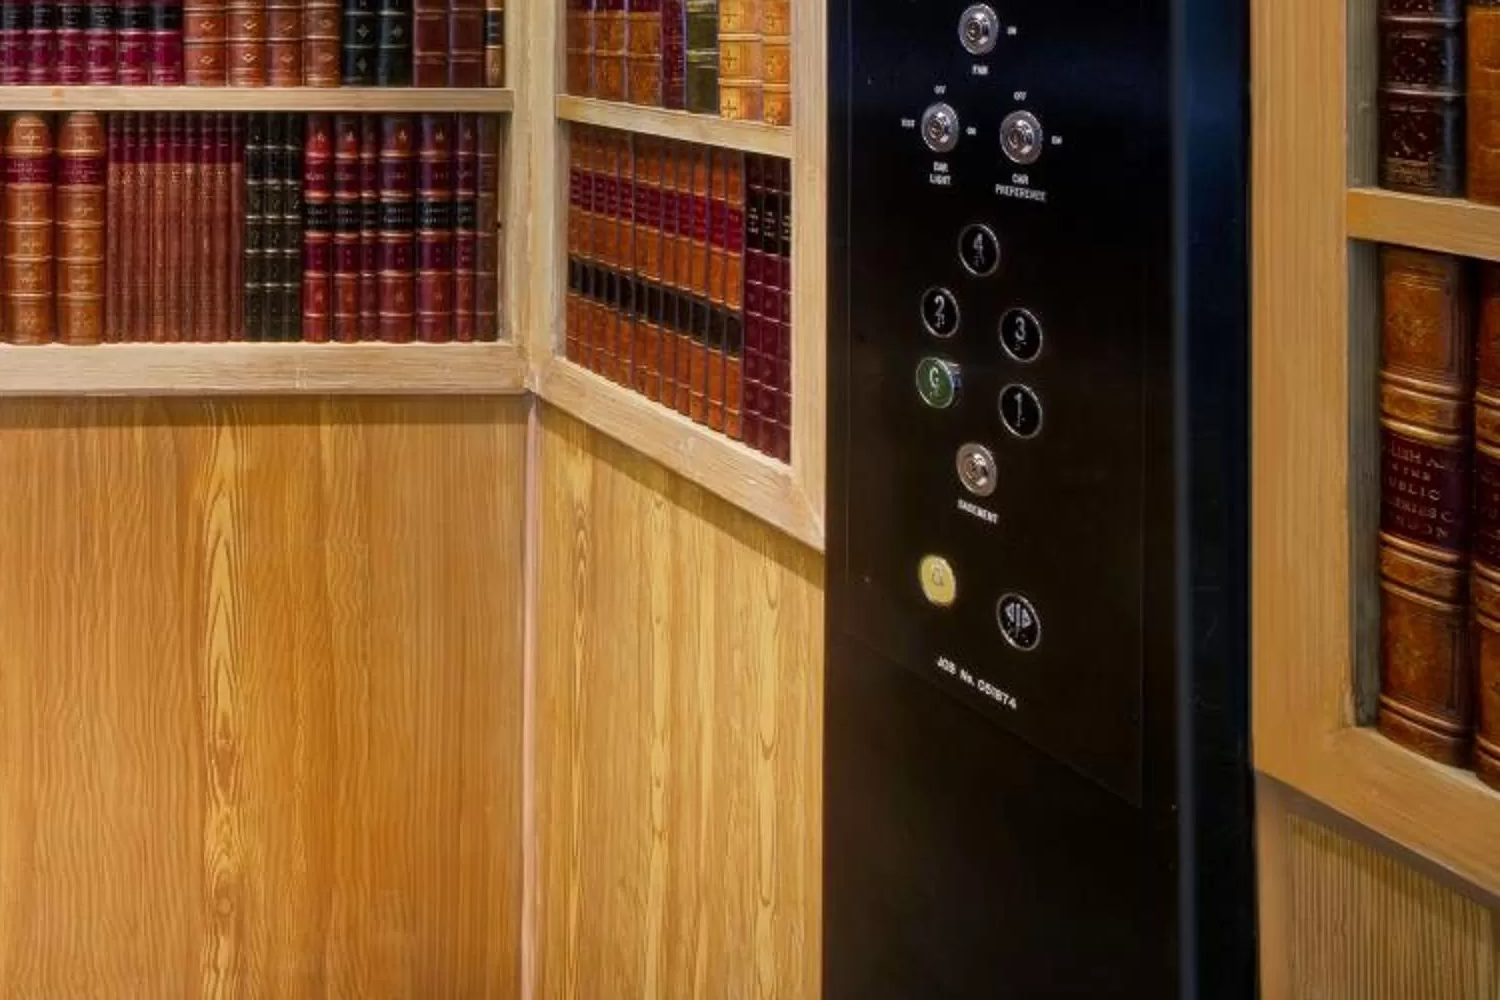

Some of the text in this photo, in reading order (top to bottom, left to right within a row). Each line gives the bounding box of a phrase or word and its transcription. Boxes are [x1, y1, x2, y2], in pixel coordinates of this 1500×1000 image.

[934, 295, 945, 316] 2
[1015, 316, 1026, 341] 3
[957, 499, 999, 524] BASEMENT
